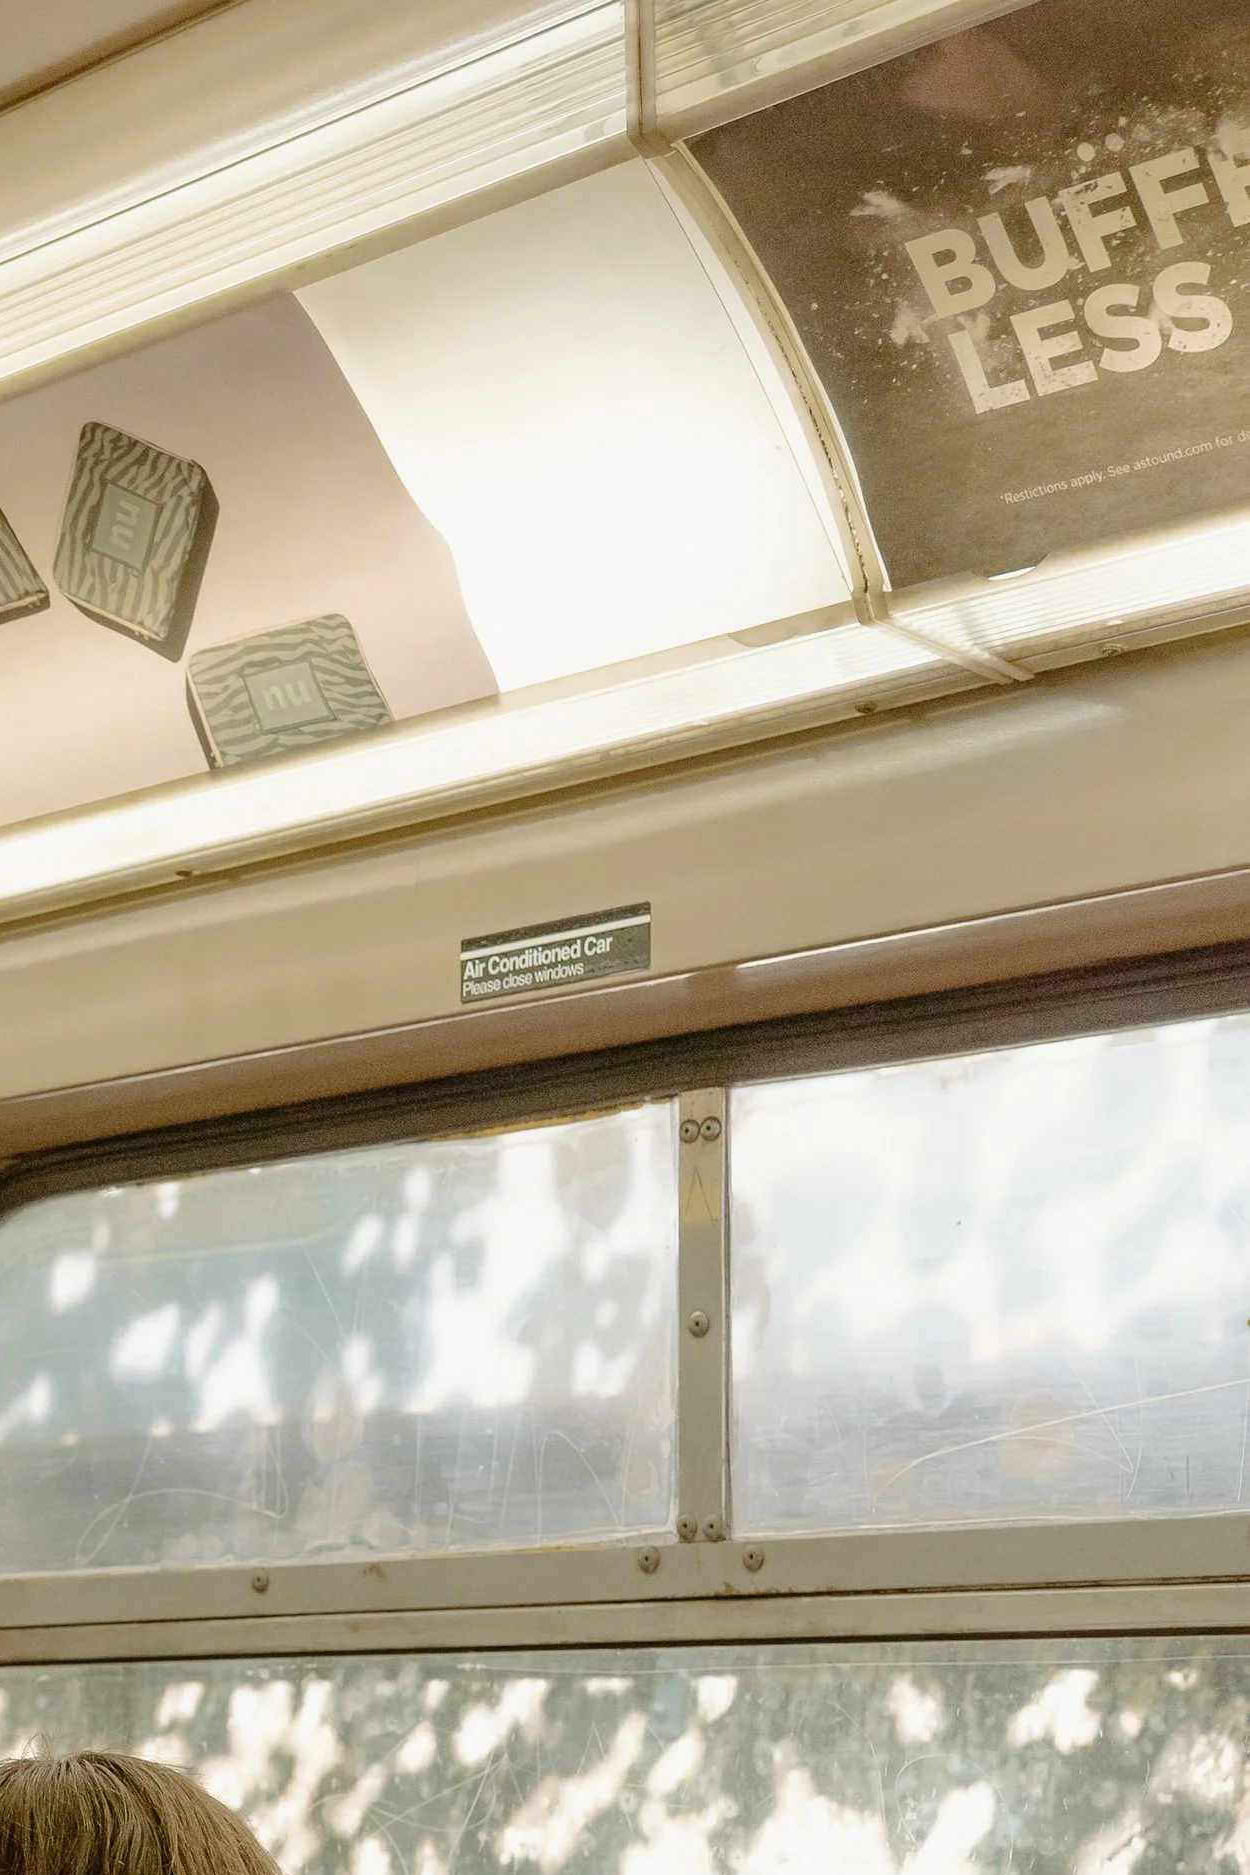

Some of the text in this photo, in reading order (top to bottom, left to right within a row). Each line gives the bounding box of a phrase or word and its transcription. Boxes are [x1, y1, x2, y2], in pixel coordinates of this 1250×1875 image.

[948, 261, 1233, 415] LESS
[1070, 470, 1107, 487] apply.
[1107, 464, 1131, 477] See
[1133, 441, 1213, 470] astound.com
[1214, 435, 1233, 448] for
[262, 681, 311, 710] nu
[462, 963, 584, 997] Please close windows
[463, 936, 614, 980] Air Conditioned Car
